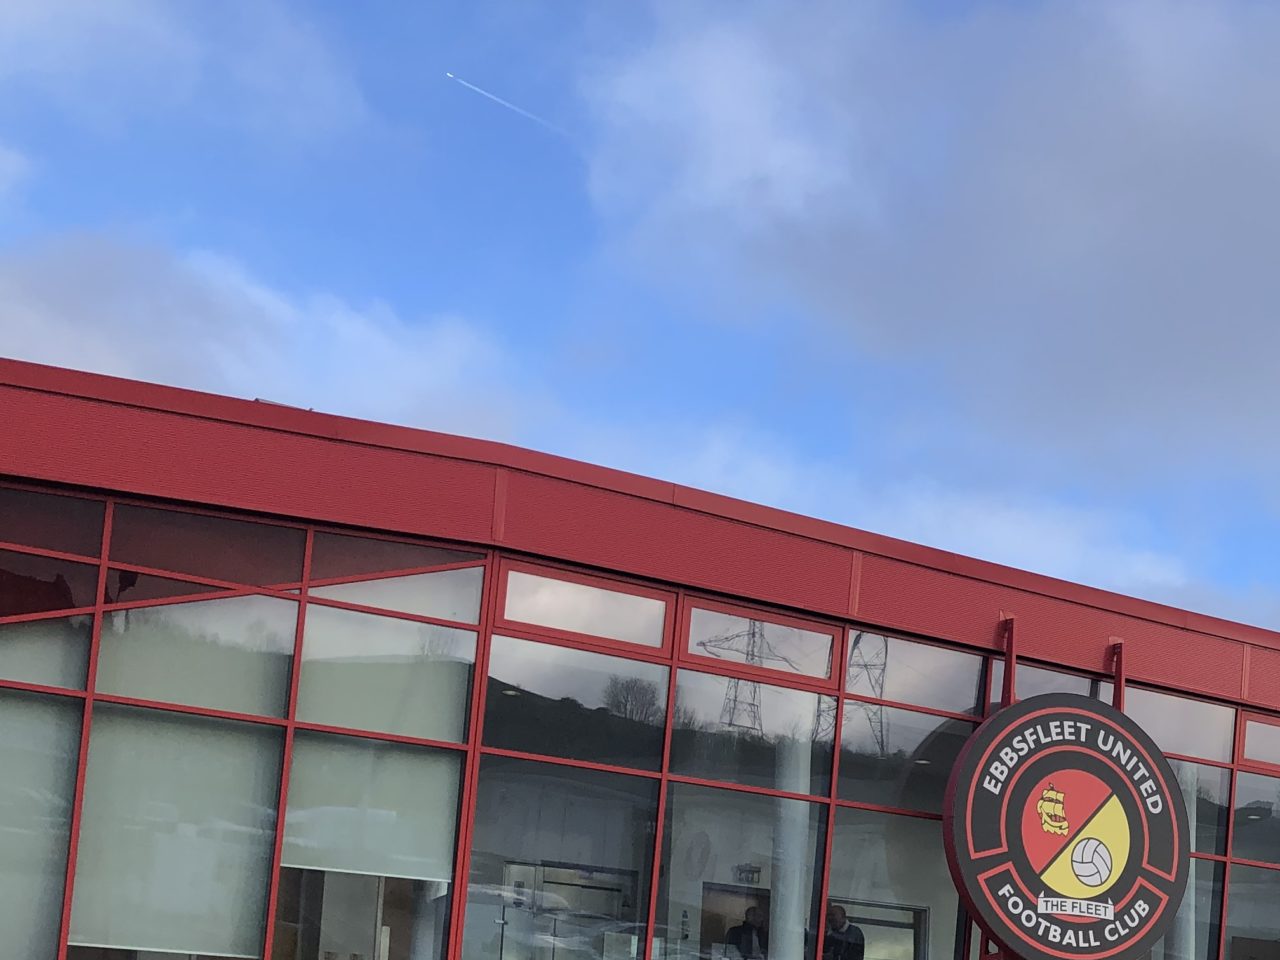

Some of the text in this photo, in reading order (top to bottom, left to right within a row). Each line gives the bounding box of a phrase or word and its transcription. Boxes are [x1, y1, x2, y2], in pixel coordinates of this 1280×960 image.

[982, 720, 1163, 815] EBBSFLEET UNITED
[998, 883, 1150, 949] FOOTBALL CLUB
[1043, 900, 1110, 917] THE FLEET
